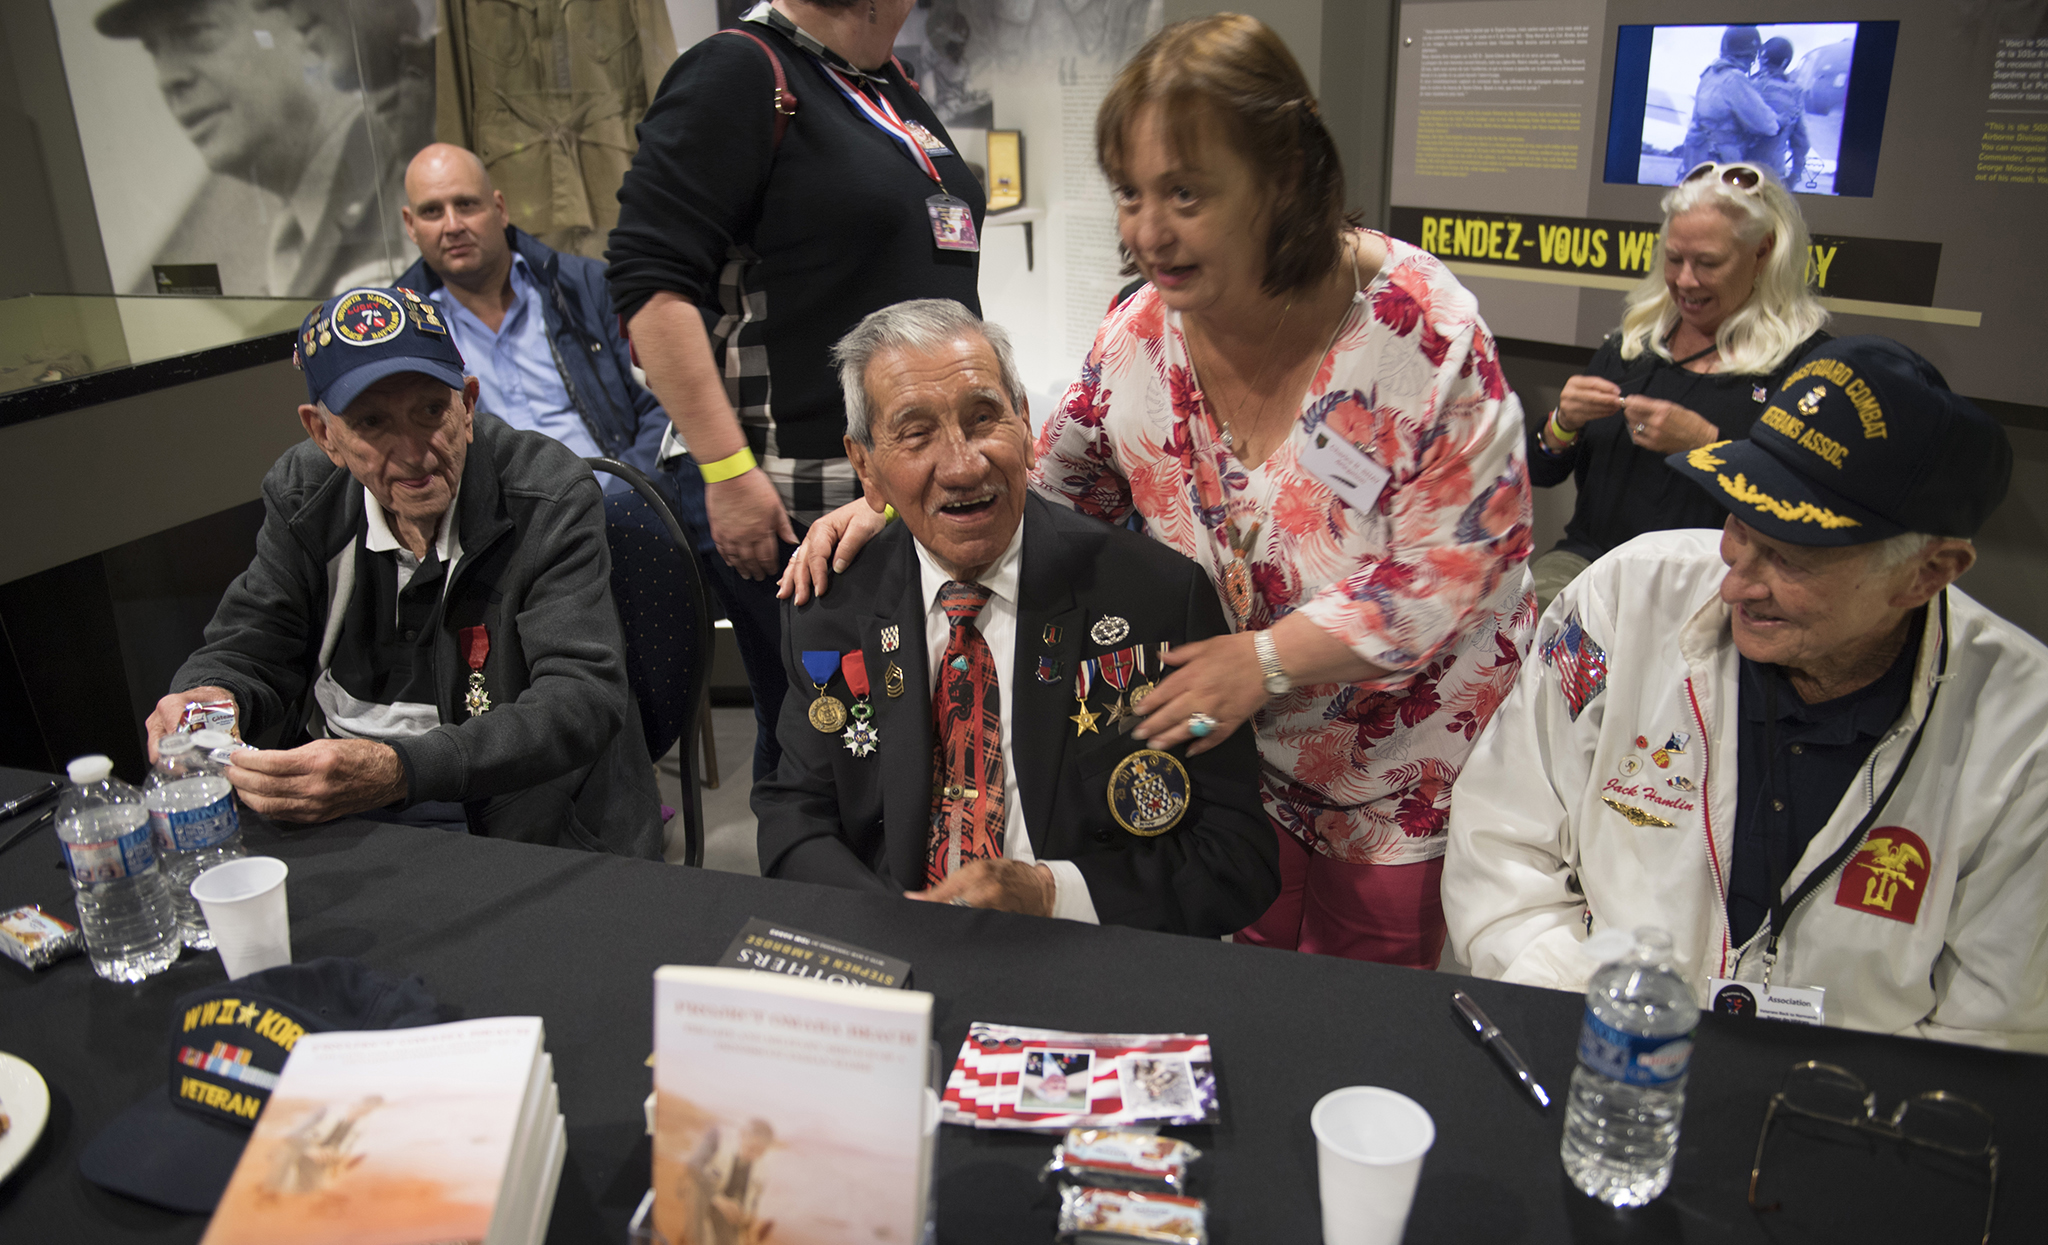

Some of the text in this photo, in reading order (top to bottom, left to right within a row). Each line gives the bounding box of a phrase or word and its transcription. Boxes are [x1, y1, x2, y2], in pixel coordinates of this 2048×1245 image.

[1982, 132, 2015, 141] Airborne
[2007, 123, 2015, 131] is
[2017, 123, 2030, 131] the
[1981, 143, 1994, 151] You
[2010, 145, 2046, 153] recognize
[1977, 162, 2004, 172] George
[2005, 164, 2036, 174] Moseley
[1988, 173, 1997, 181] of
[1998, 174, 2009, 182] his
[1421, 216, 1608, 268] RENDEZ-VOUS
[1618, 230, 1660, 272] WI
[347, 302, 380, 316] LUCKY
[1811, 358, 1854, 388] GUARD
[1844, 377, 1889, 440] COMBAT
[1797, 427, 1850, 471] ASSOC.
[1602, 778, 1695, 812] Jack Hamlin
[745, 933, 896, 987] STEPHEN E. AMBROSE
[1767, 996, 1812, 1008] Association
[255, 1008, 306, 1053] KOR
[180, 1075, 261, 1120] VETERAN
